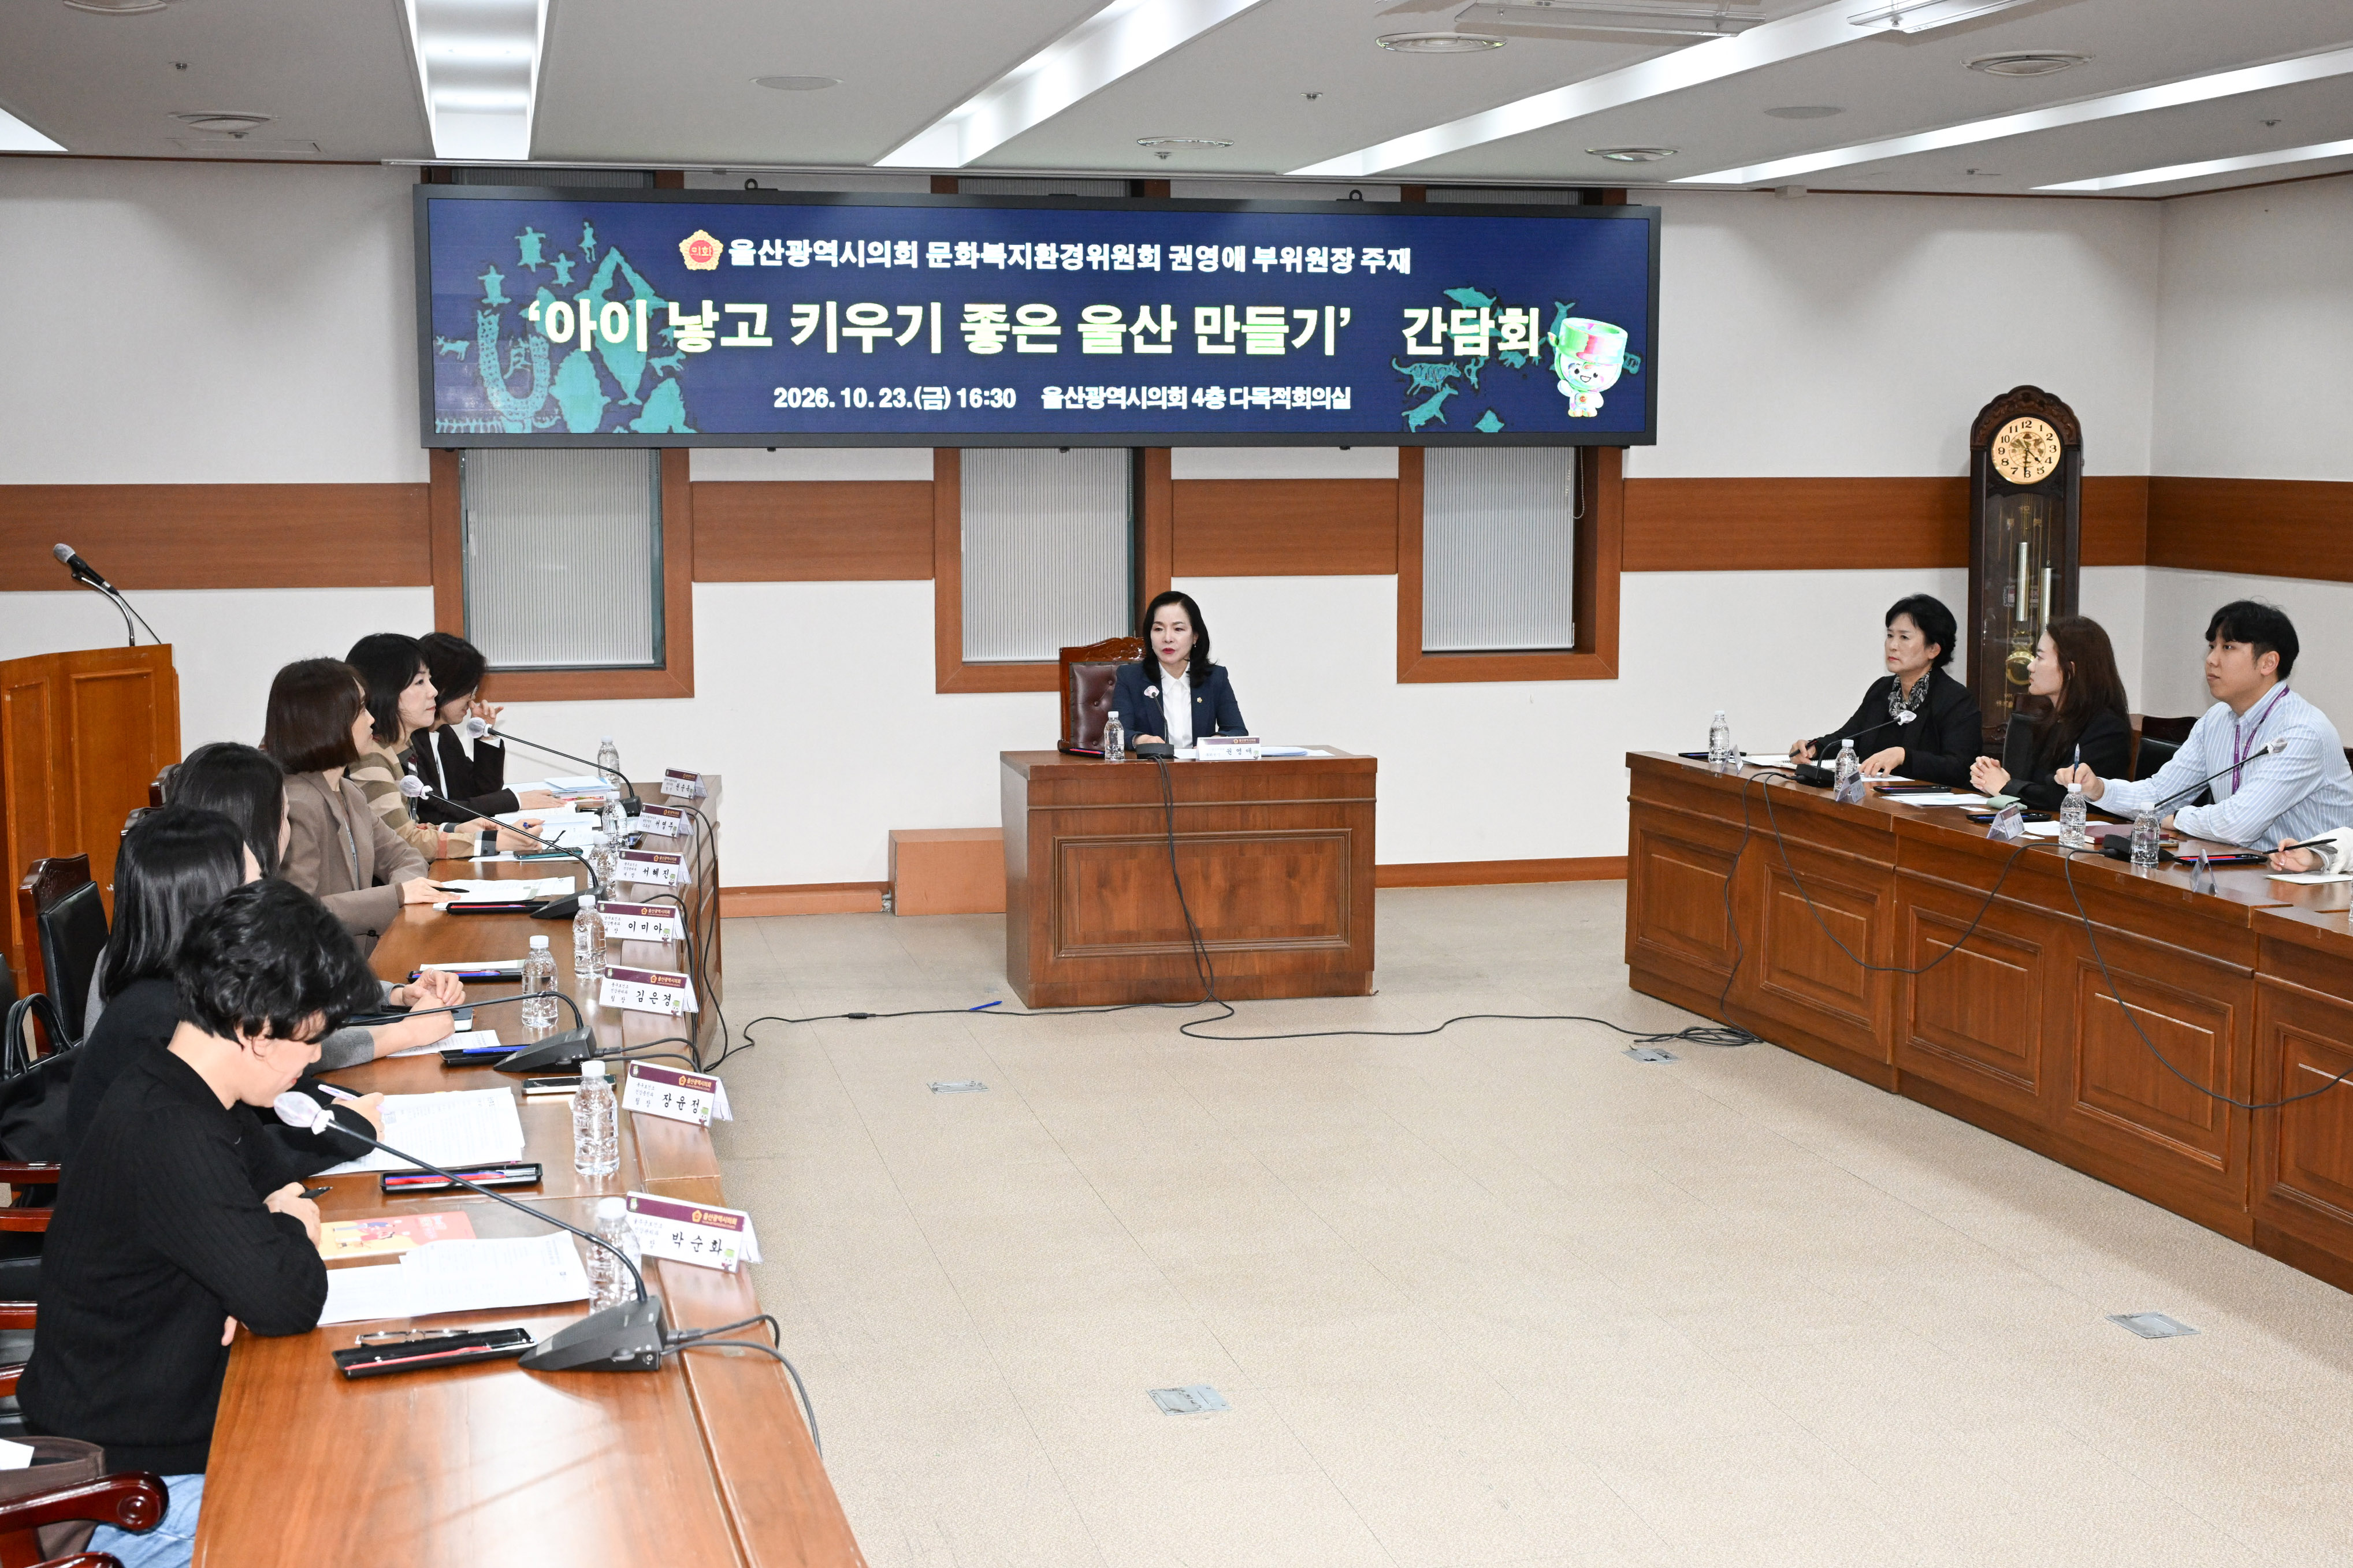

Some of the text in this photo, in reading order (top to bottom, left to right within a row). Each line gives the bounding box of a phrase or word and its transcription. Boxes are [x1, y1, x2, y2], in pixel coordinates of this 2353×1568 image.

[729, 239, 1411, 274] 울산광역시의회 문화복지환경위원회 권영애 부위원장 주재
[668, 300, 773, 352] 낳고
[790, 301, 942, 353] 키우기
[960, 304, 1062, 354] 좋은
[1077, 304, 1177, 353] 울산
[1402, 307, 1539, 356] 간담회
[774, 386, 1016, 411] 2026. 10. 23.(금) 16:30
[1041, 386, 1351, 409] 울산광역시의회 4층 다목적회의실
[2010, 425, 2019, 433] 11
[2021, 420, 2032, 429] 12
[2049, 445, 2057, 453] 3
[2001, 458, 2009, 466] 8
[2025, 470, 2031, 478] 6
[2037, 466, 2045, 474] 5
[642, 867, 669, 879] 서혜진
[628, 921, 663, 934] 이미아
[635, 990, 671, 1007] 김은경
[662, 1093, 700, 1113] 장윤정
[672, 1231, 723, 1256] 박순화
